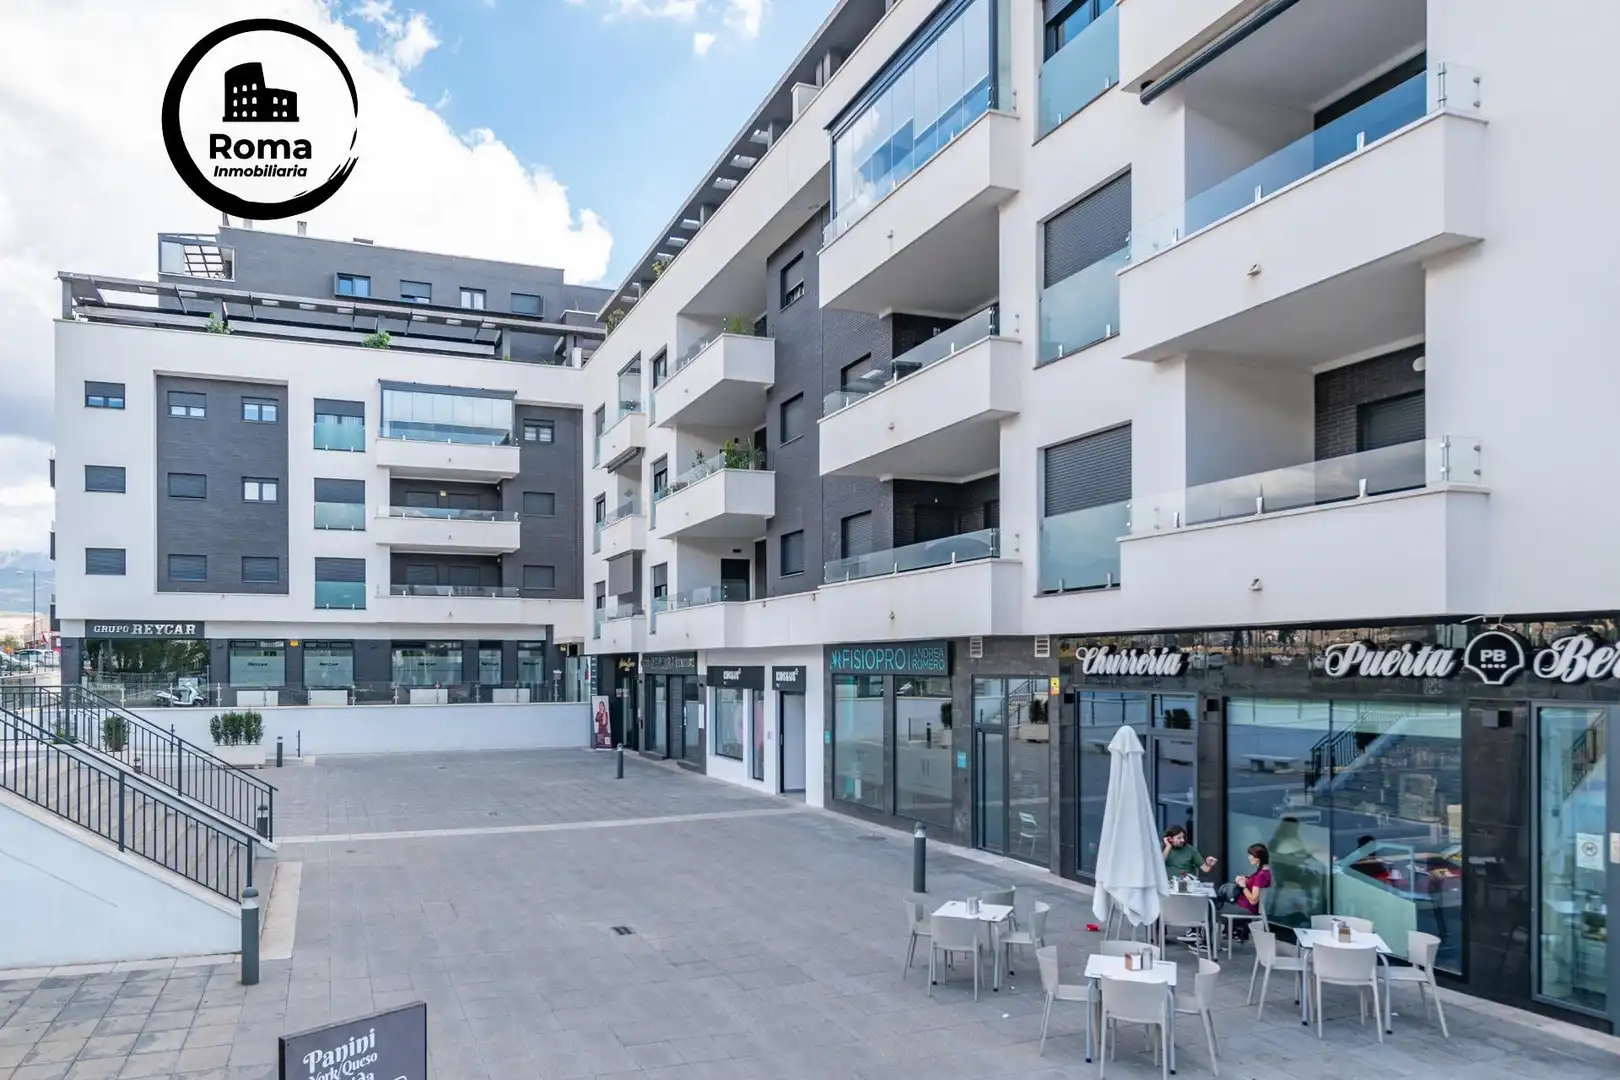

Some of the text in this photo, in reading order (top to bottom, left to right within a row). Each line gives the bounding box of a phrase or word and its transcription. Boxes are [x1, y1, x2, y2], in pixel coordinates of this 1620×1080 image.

[93, 623, 196, 635] GRUPO REYCAR
[842, 648, 906, 670] FISIOPRO
[911, 647, 944, 659] ANDREA
[1325, 640, 1455, 677] Puerta
[1480, 650, 1507, 662] PB
[912, 659, 946, 670] ROMERO
[302, 1028, 376, 1074] Panini
